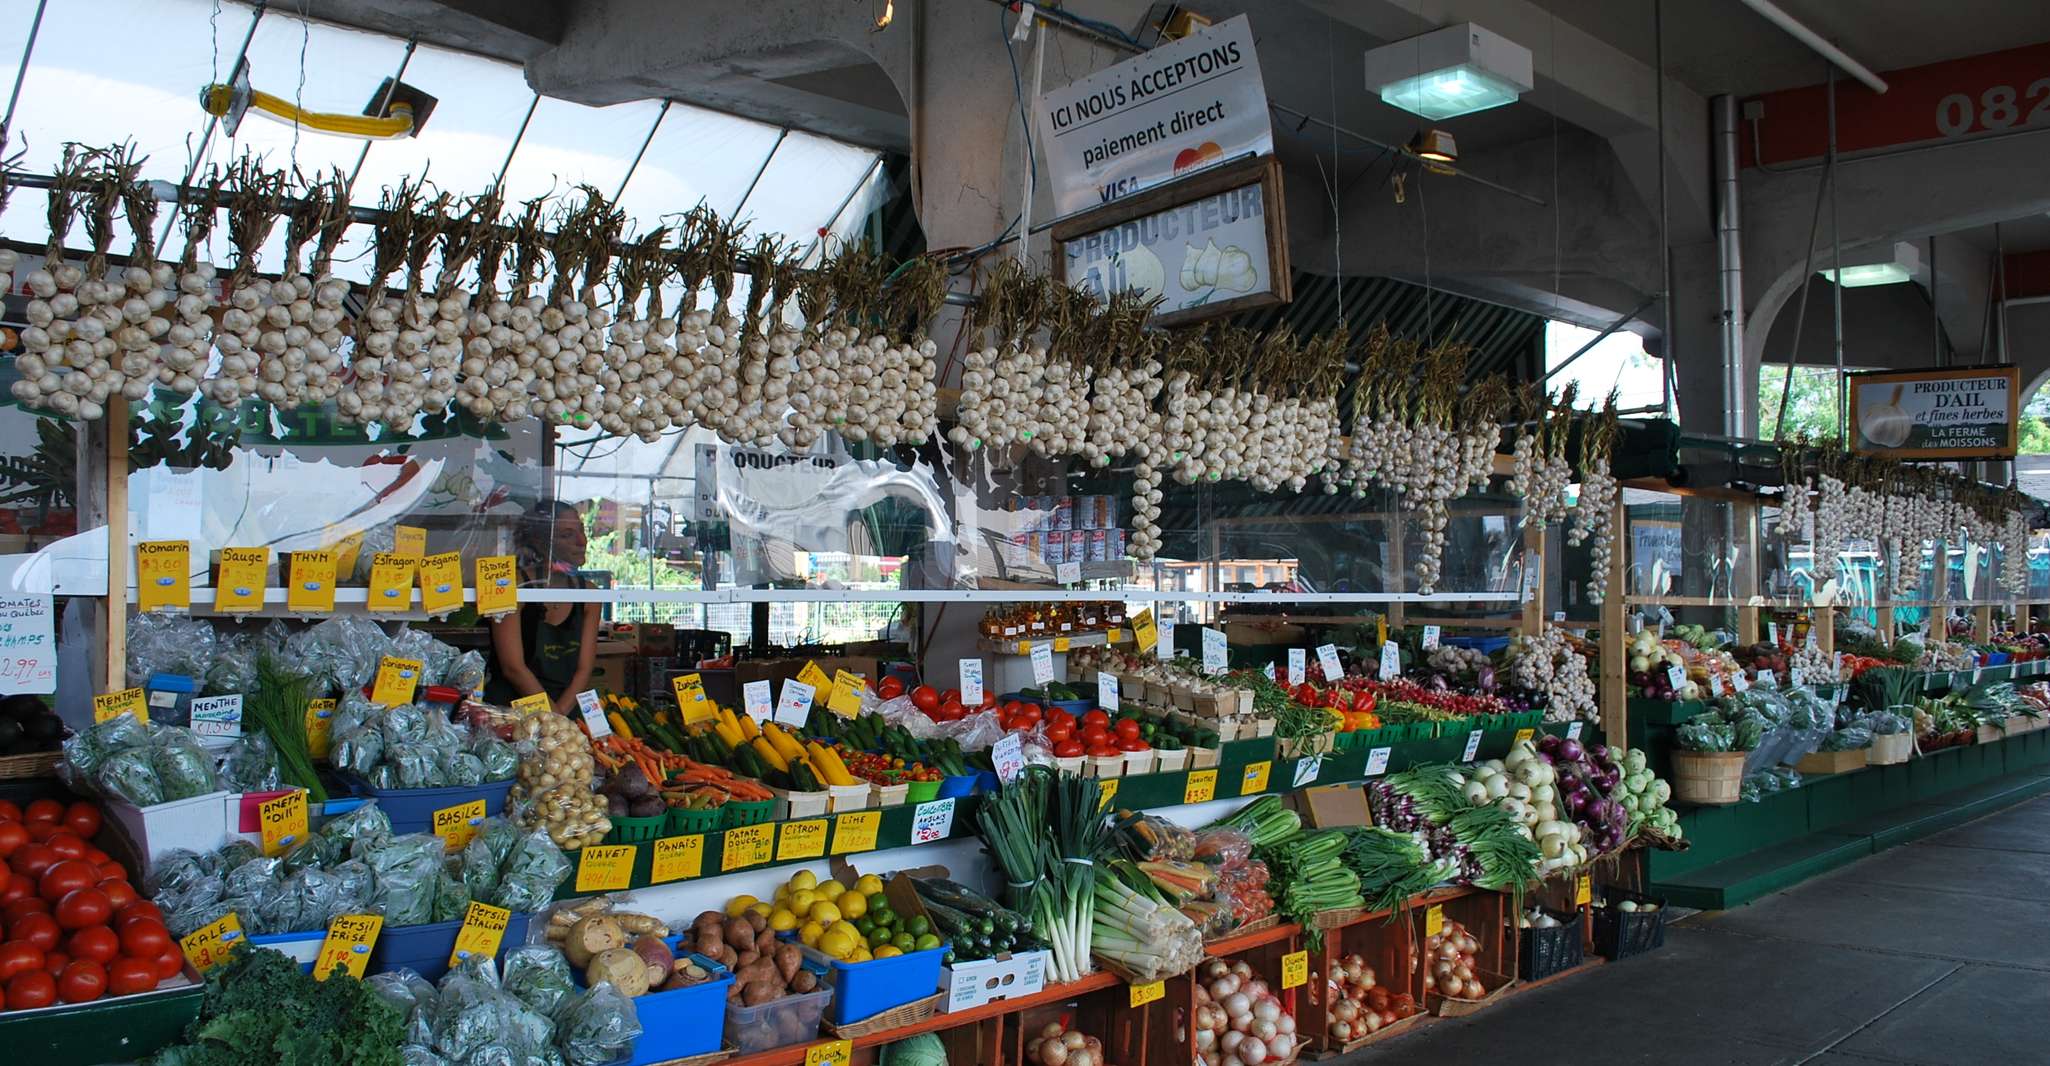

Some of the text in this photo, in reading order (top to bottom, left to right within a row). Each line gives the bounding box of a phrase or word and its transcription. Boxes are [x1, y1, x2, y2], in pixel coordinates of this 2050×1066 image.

[1051, 41, 1241, 130] ICI NOUS ACCEPTONS
[1083, 120, 1166, 169] paiement
[1171, 100, 1225, 142] direct
[1099, 176, 1141, 202] VISA
[1064, 183, 1263, 268] PRODUCTEUR
[1914, 378, 2006, 394] PRODUCTEUR
[1935, 392, 1985, 408] D'AIL
[1915, 407, 2004, 425] et fines herbes
[1931, 427, 1986, 438] LA FERME
[1921, 436, 1996, 449] des MOISSONS
[139, 543, 189, 555] Romarin
[223, 548, 263, 566] Sauge
[96, 689, 142, 708] MENTHE
[194, 698, 238, 713] MENTHE
[263, 792, 302, 814] ANETH
[586, 848, 628, 860] NAVET
[335, 916, 375, 933] Persil
[185, 923, 227, 951] KALE
